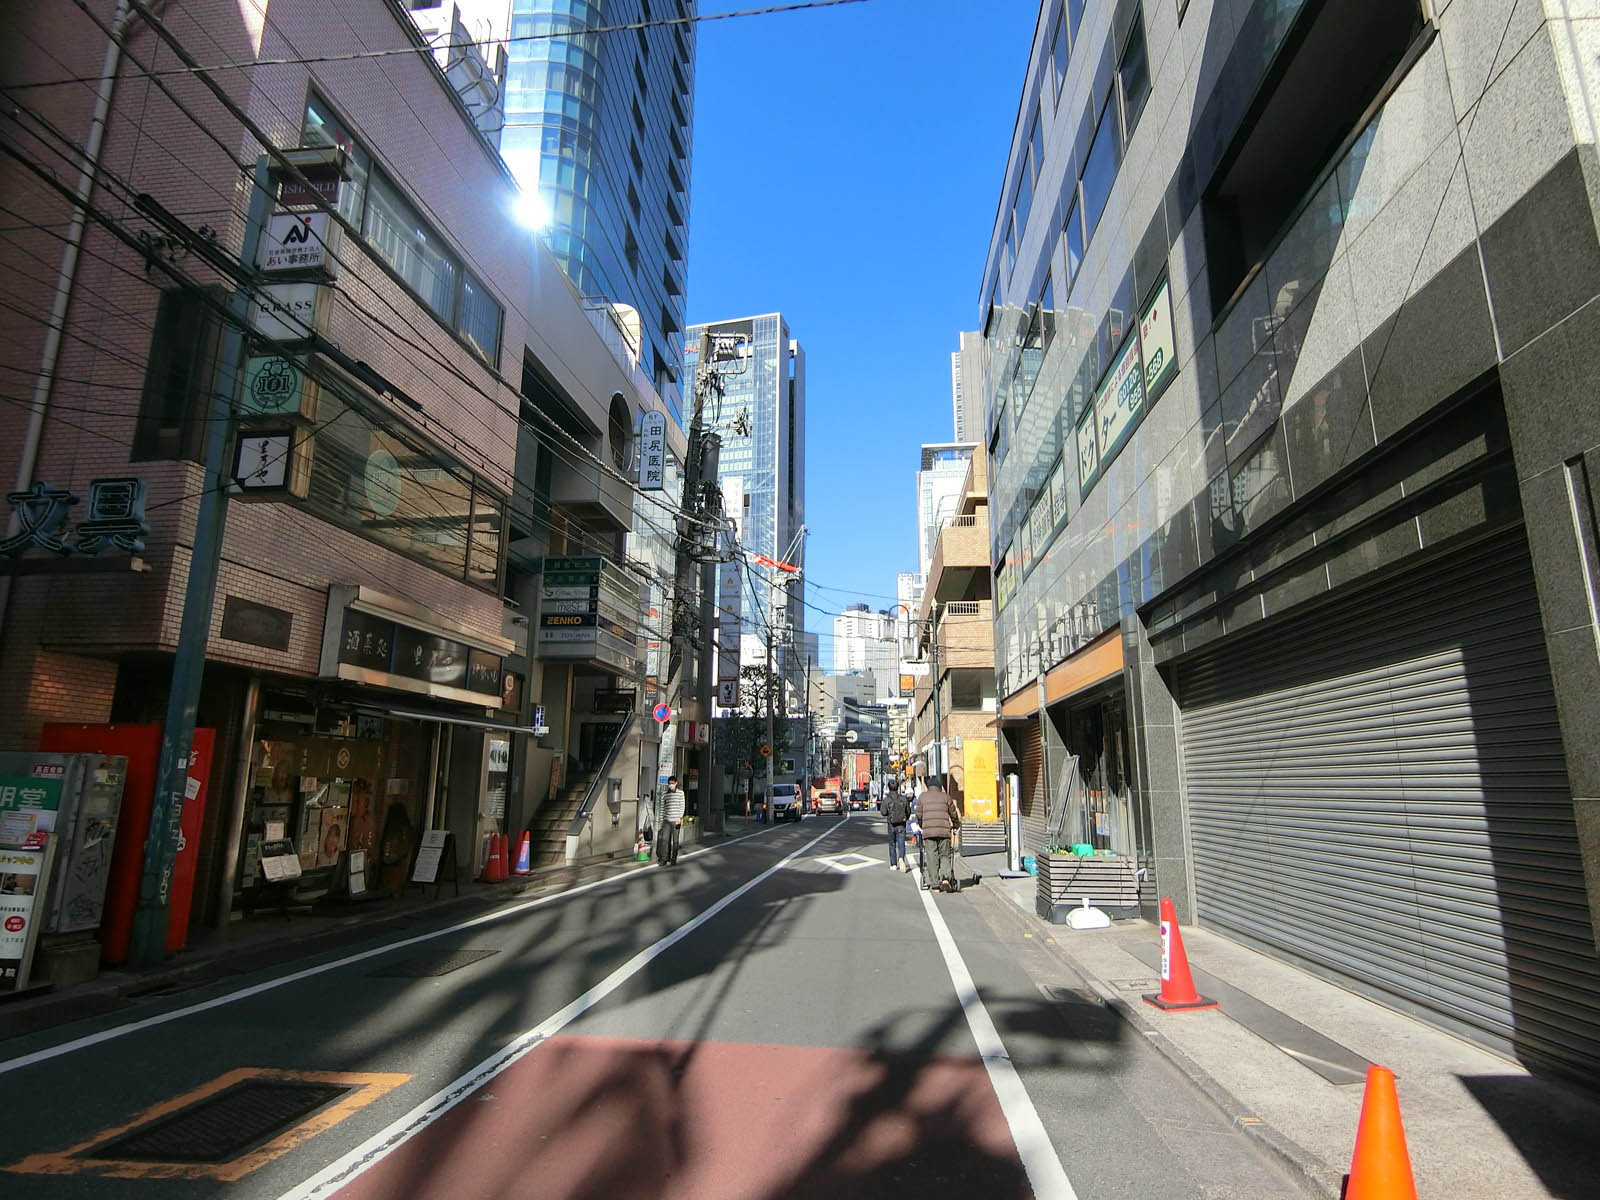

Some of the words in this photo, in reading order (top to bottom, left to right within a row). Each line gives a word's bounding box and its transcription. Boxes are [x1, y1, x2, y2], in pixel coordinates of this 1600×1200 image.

[266, 253, 320, 266] あい事務所
[646, 425, 662, 482] 田尻医院
[546, 616, 582, 625] ZENKO
